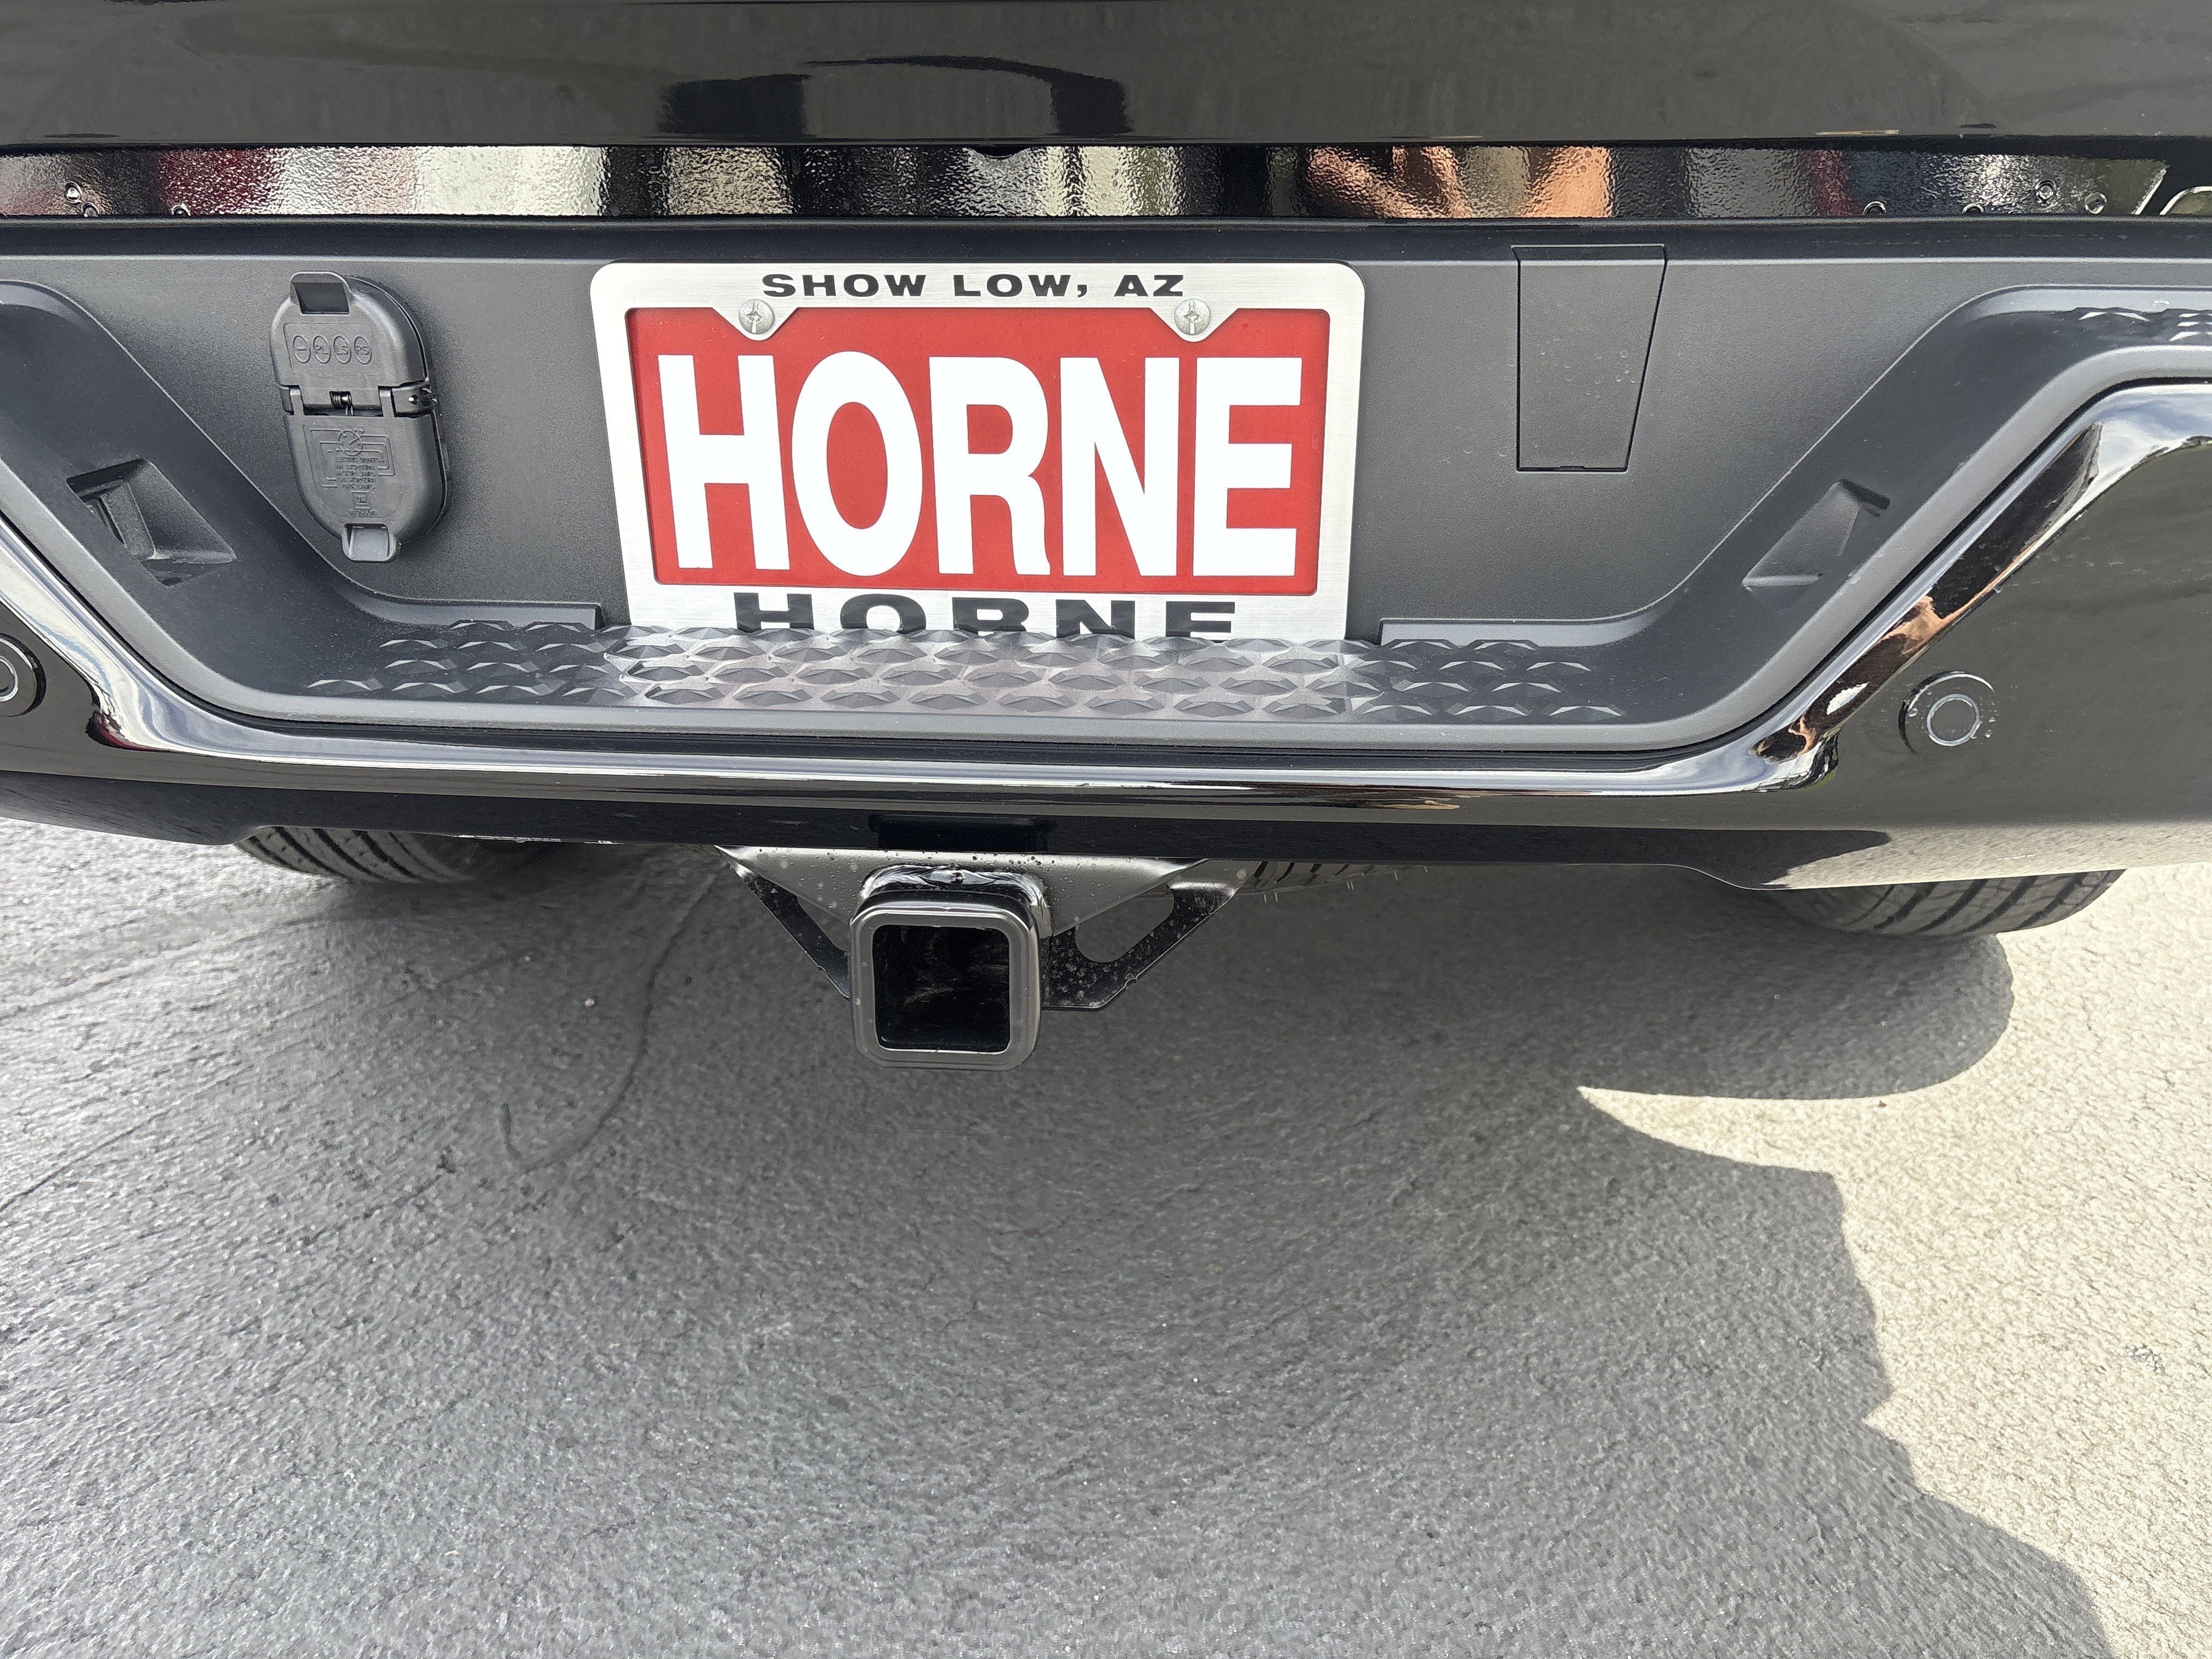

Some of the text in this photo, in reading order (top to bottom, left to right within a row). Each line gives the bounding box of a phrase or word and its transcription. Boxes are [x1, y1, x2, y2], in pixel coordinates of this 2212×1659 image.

[761, 273, 1184, 298] SHOW LOW, AZ
[658, 351, 1302, 577] HORNE
[733, 592, 1235, 641] HORNE
